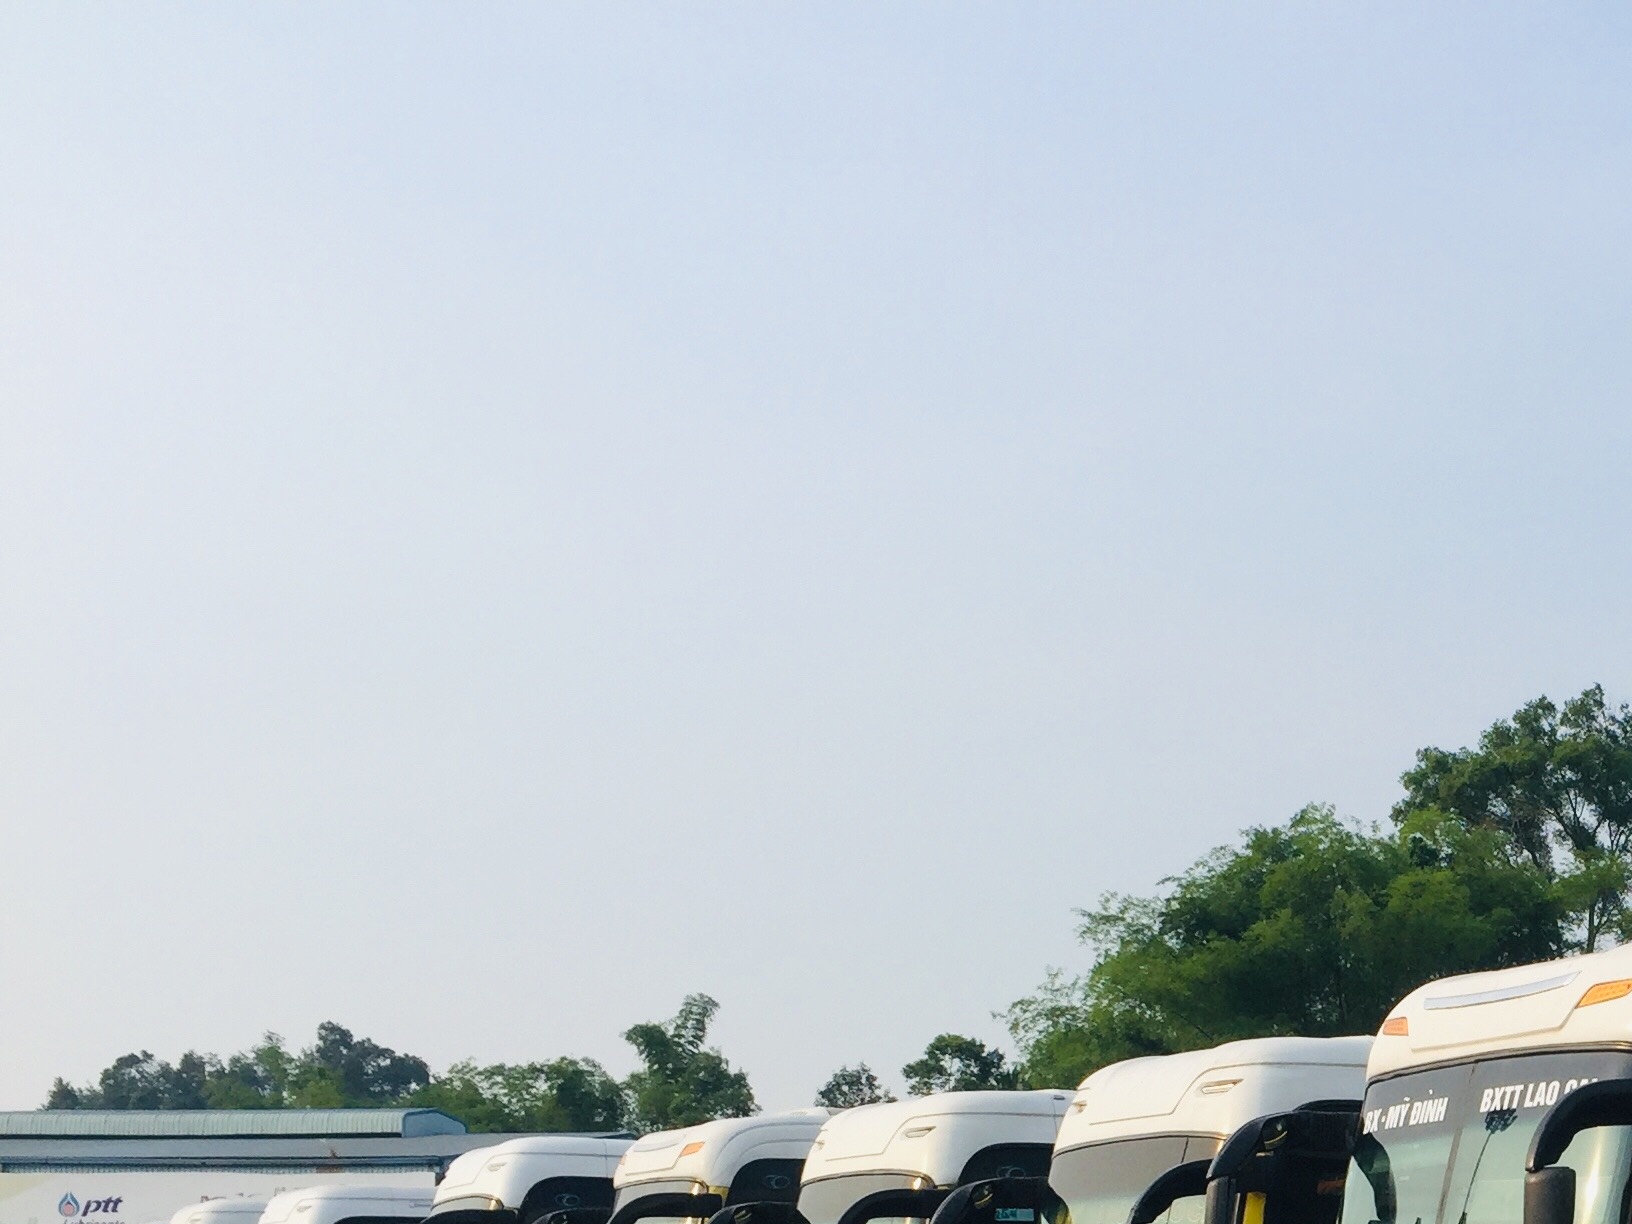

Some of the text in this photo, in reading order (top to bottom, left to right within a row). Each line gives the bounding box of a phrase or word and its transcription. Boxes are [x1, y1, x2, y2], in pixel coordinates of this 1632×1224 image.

[1479, 1082, 1525, 1114] BXTT
[1524, 1080, 1560, 1109] LAO
[81, 1195, 123, 1217] ptt
